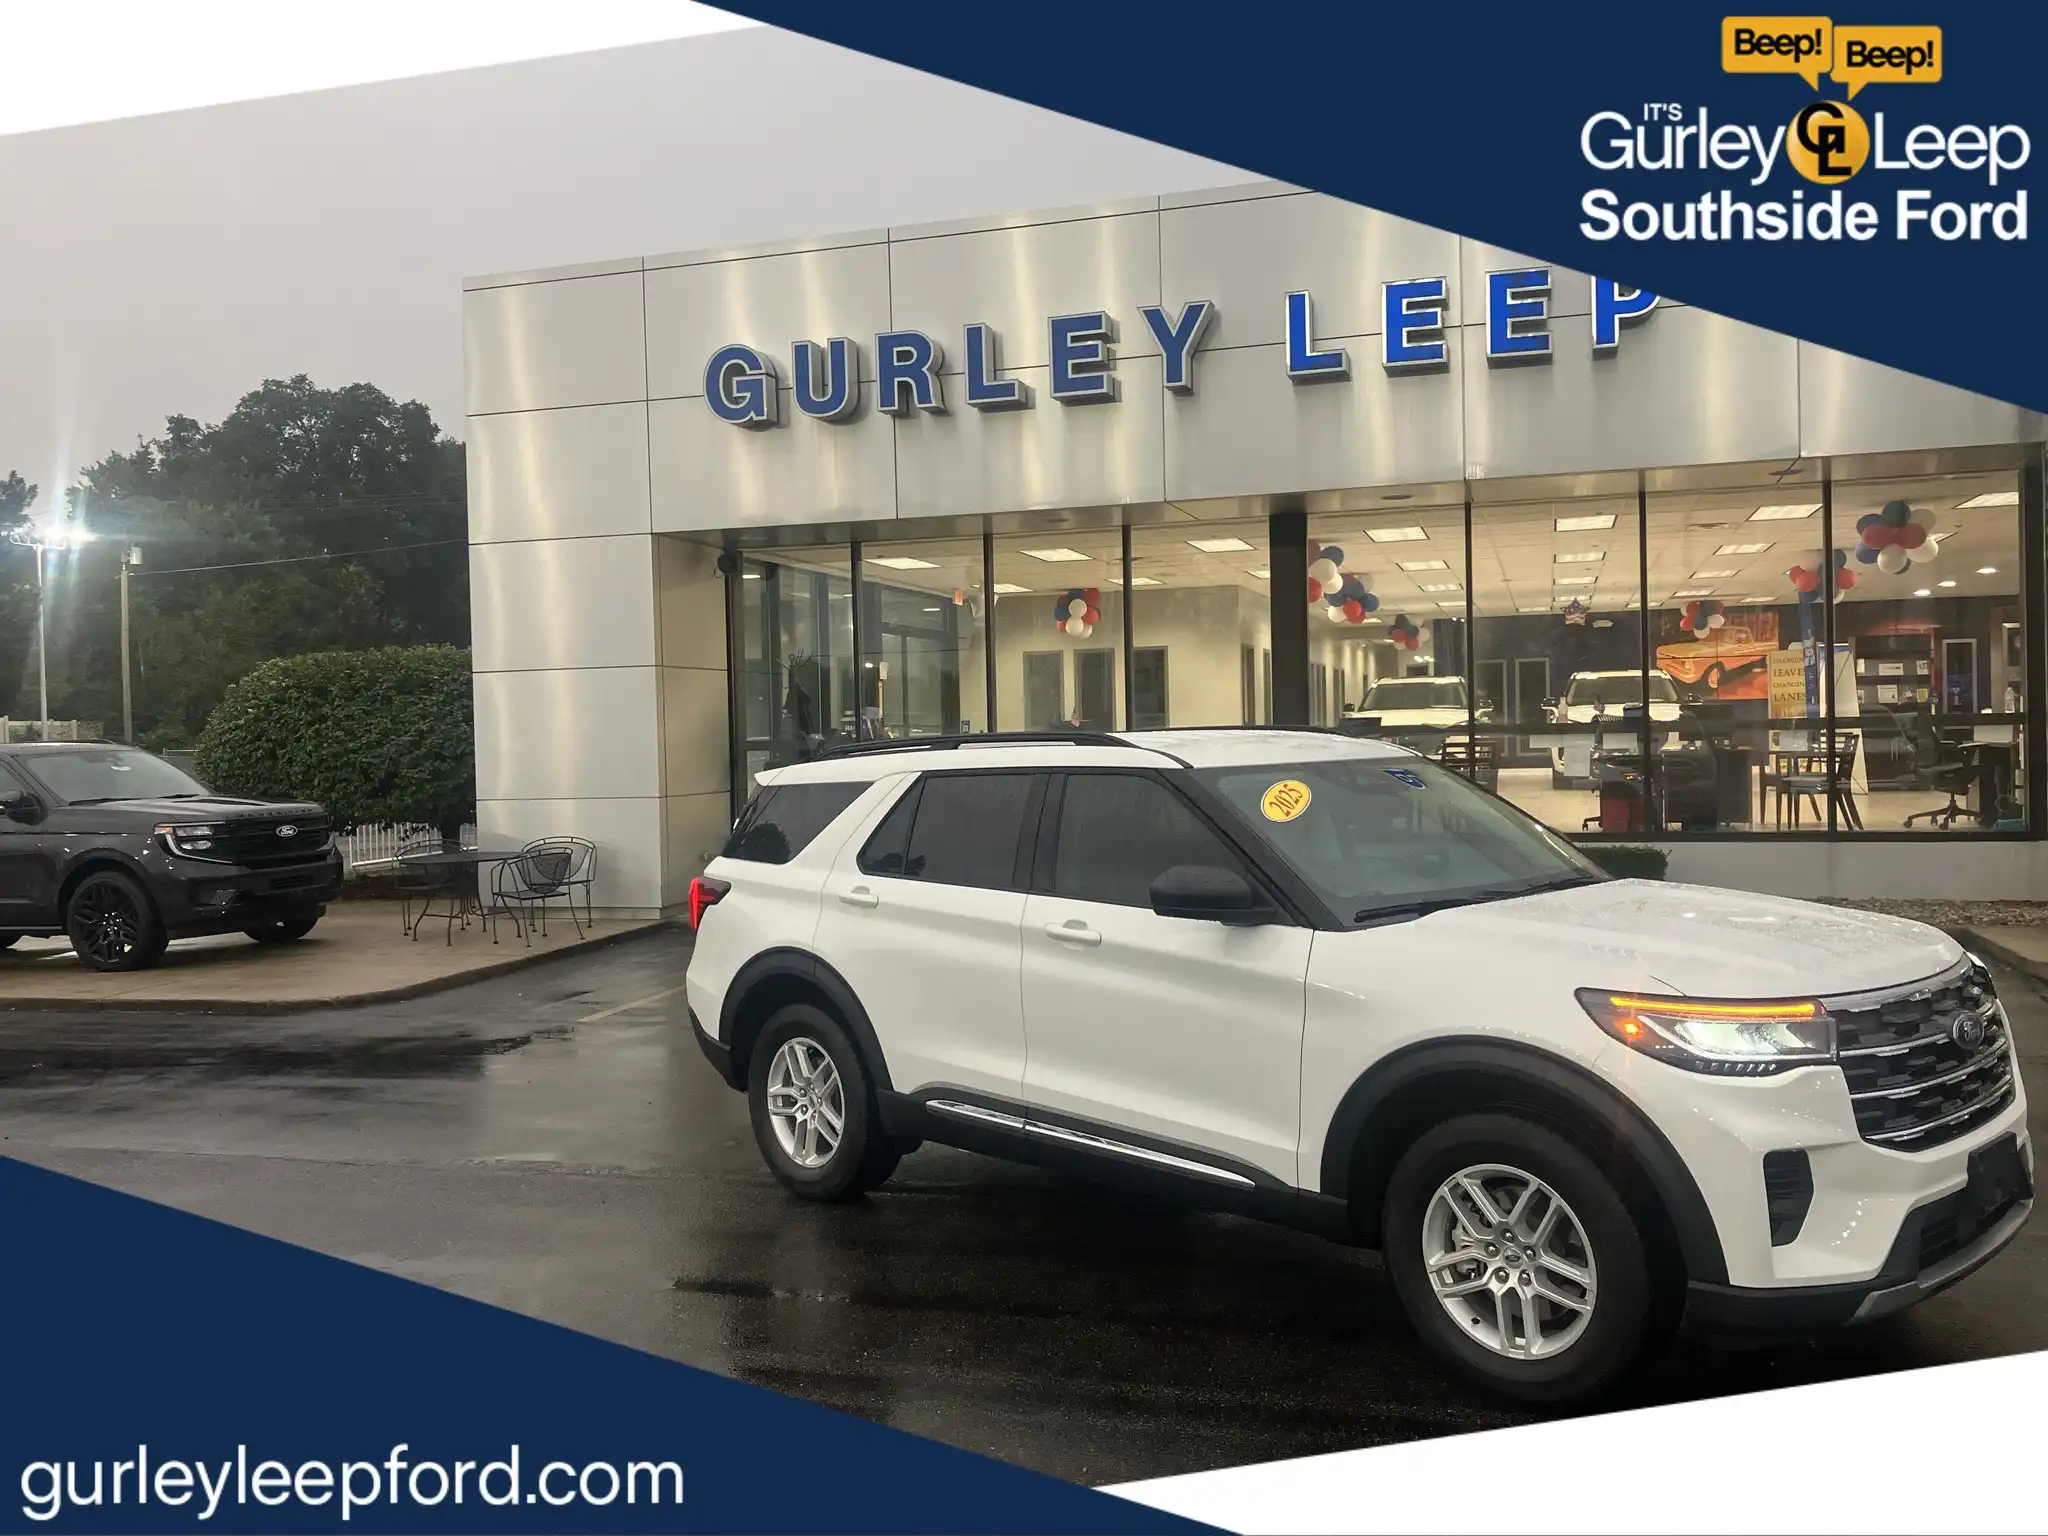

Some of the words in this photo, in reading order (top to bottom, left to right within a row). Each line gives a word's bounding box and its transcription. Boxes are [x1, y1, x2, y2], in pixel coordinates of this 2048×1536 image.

[703, 300, 1216, 428] GURLEY
[1285, 265, 1662, 382] LEEP
[1269, 784, 1303, 817] 2025
